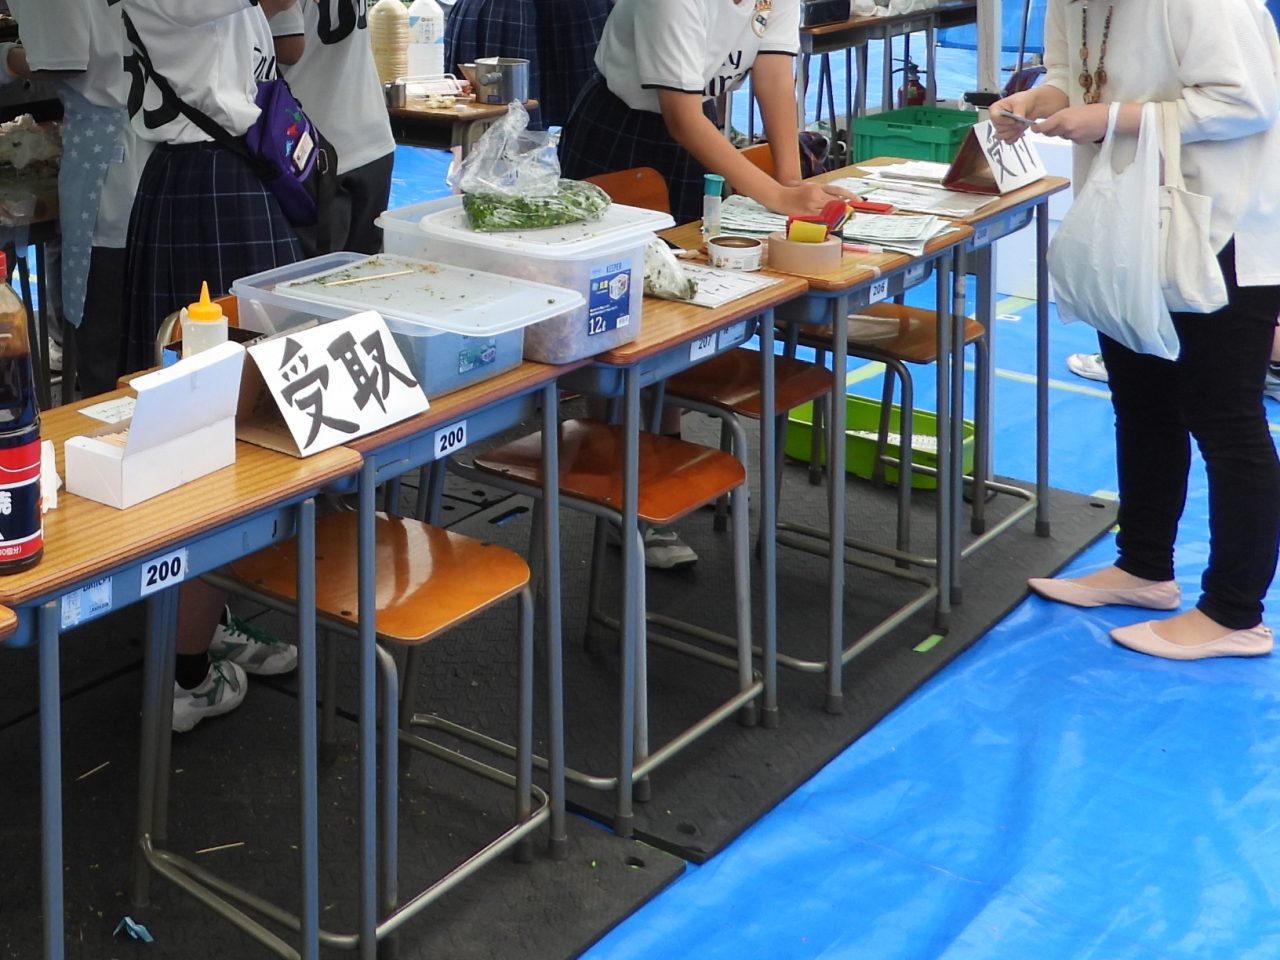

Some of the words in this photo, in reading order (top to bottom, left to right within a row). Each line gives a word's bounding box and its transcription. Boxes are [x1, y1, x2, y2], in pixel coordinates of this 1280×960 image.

[278, 330, 419, 450] 受取
[439, 426, 465, 452] 200
[146, 556, 182, 587] 200
